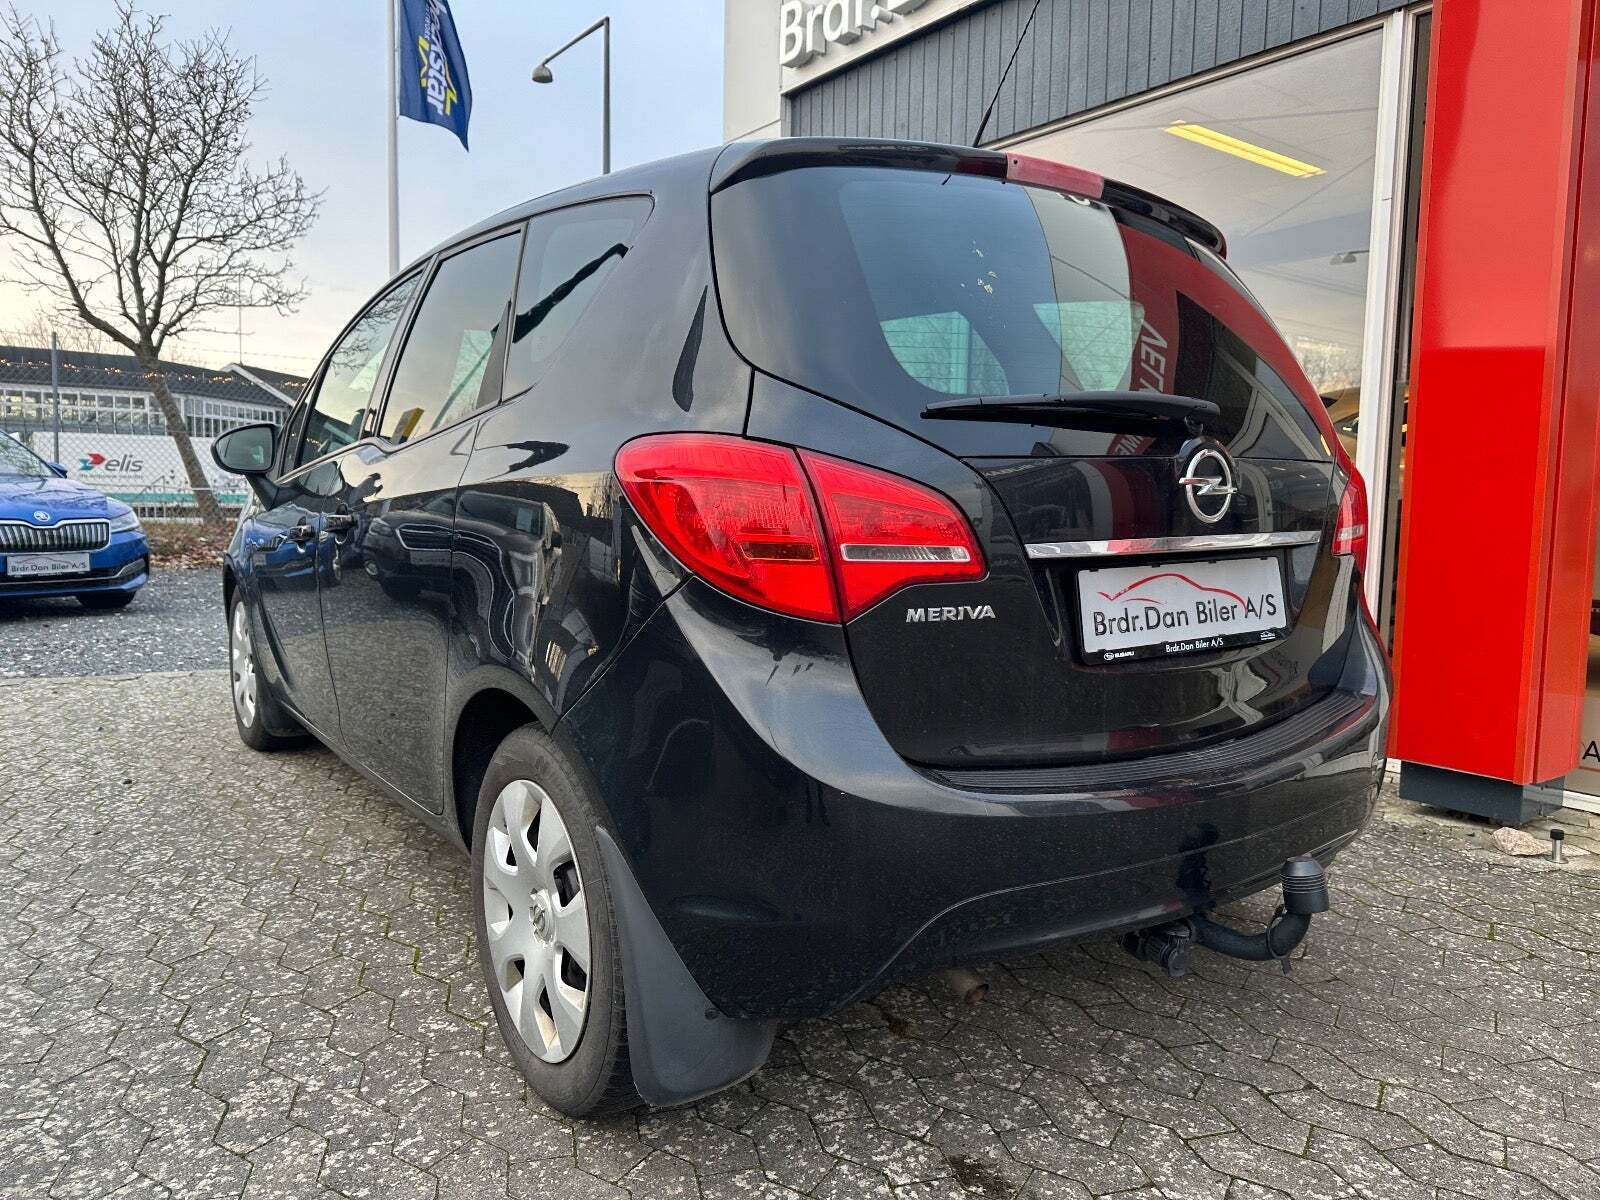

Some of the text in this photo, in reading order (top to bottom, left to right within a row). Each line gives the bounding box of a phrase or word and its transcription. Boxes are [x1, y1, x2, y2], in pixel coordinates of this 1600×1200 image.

[104, 453, 144, 473] elis
[905, 604, 996, 623] MERIVA
[1093, 593, 1278, 636] Brdr.Dan Biler A/S
[1210, 637, 1224, 647] A/S
